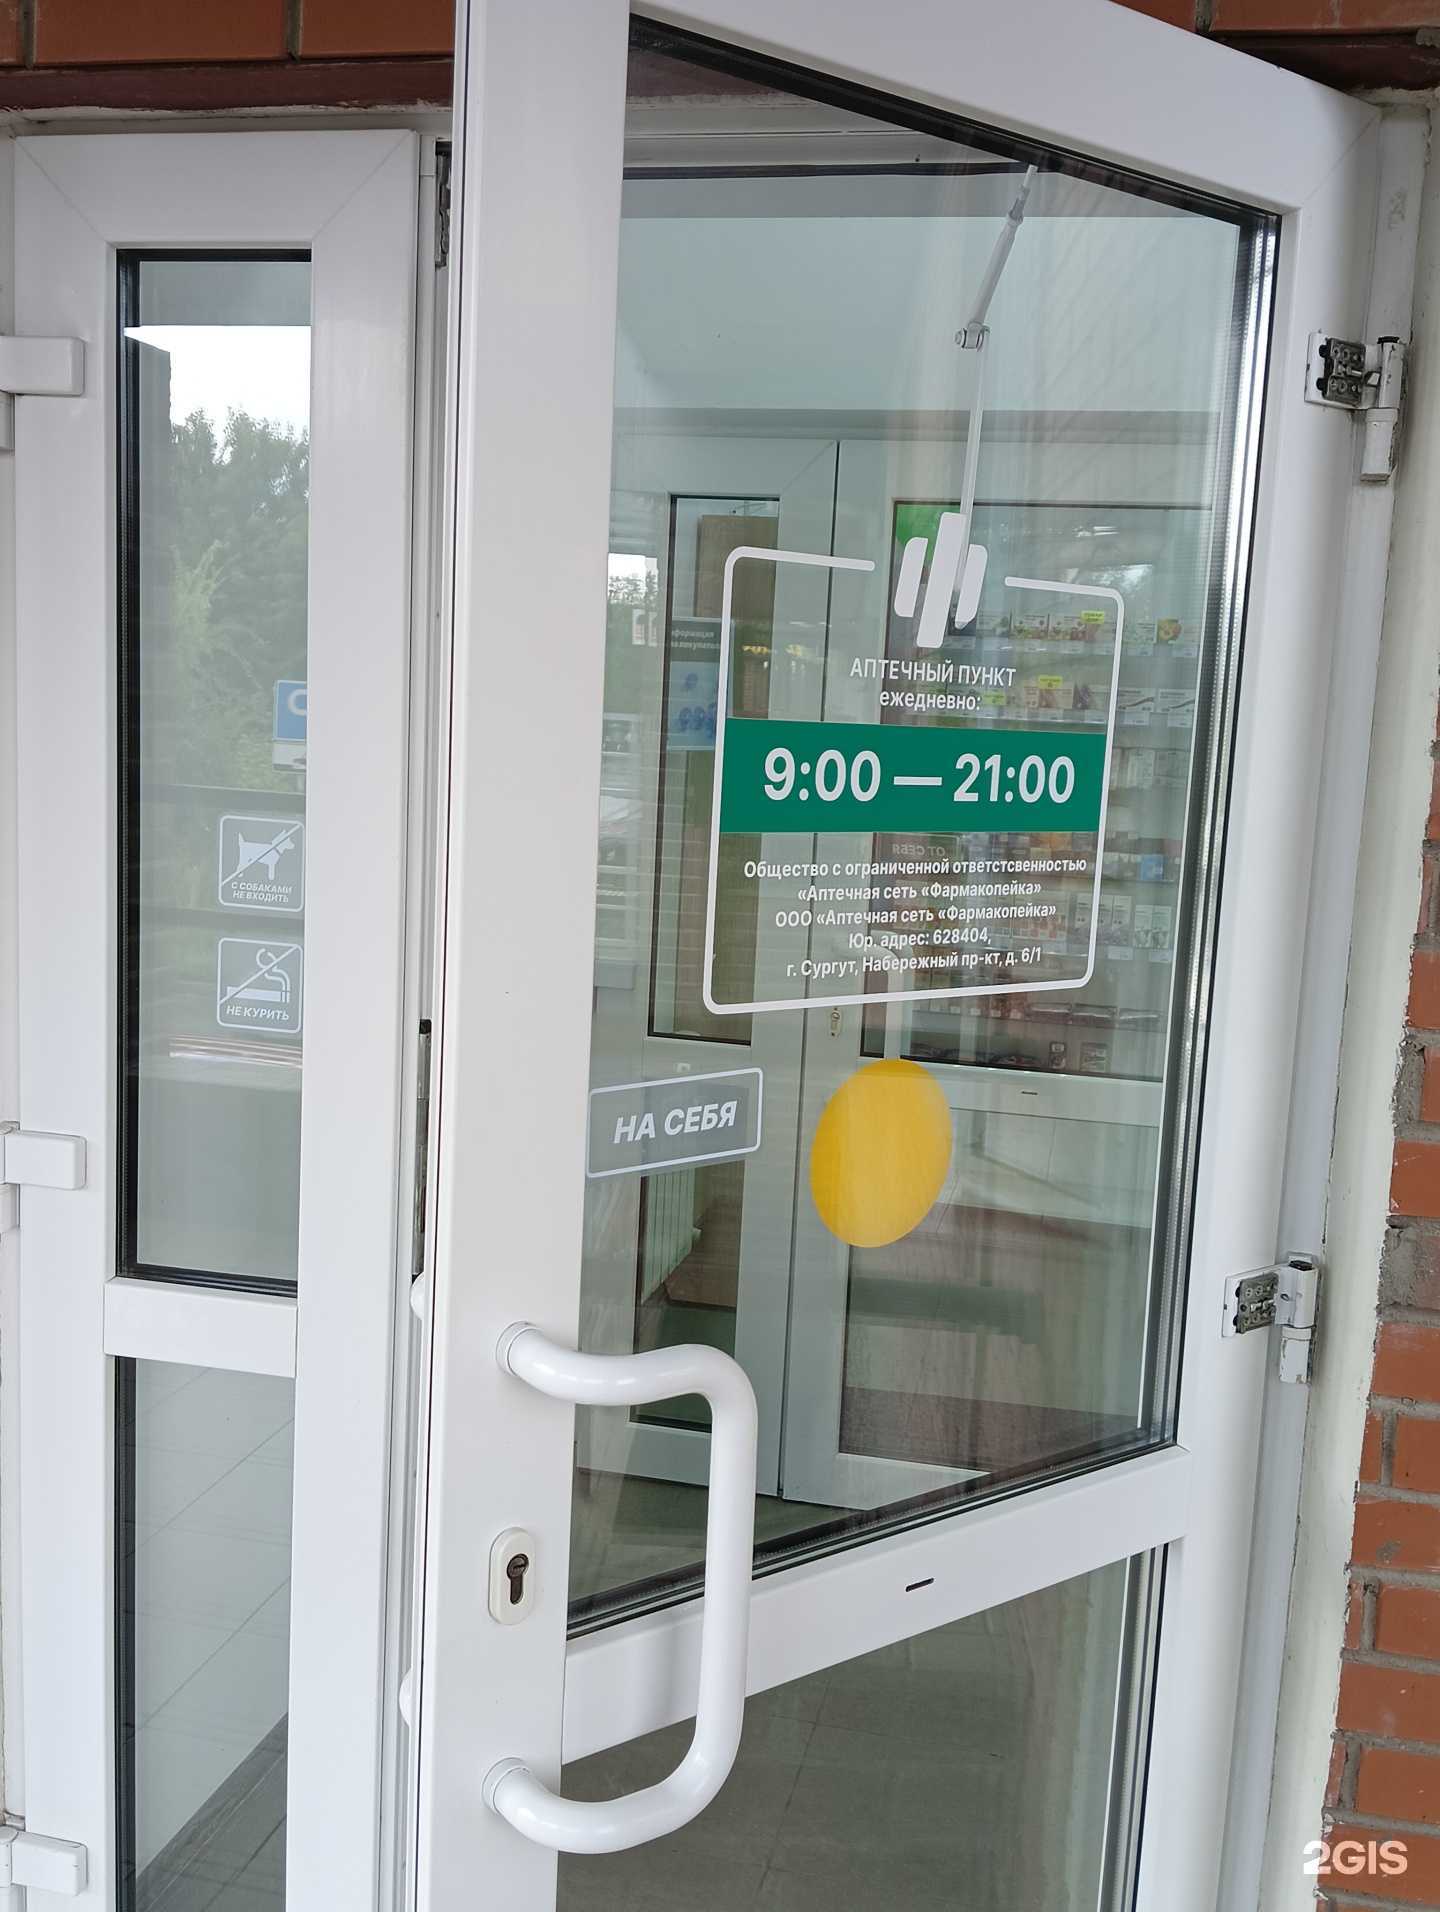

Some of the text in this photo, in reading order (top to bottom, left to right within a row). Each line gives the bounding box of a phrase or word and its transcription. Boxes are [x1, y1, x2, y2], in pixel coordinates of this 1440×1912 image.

[850, 658, 953, 684] АПТЕЧНЫЙ
[958, 665, 1017, 688] ПУНКТ
[879, 692, 981, 711] ежедневно:
[764, 747, 882, 802] 9:00
[953, 752, 1075, 804] 21:00
[744, 857, 1087, 880] Общество с ограниченной ответстсвенностью
[239, 882, 293, 895] СОБАКАМИ
[798, 880, 1042, 901] «Аптечная сеть «Фармакопейка»
[775, 902, 1057, 928] ООО «Аптечная сеть «Фармакопейка»
[849, 927, 991, 951] Юр. адрес: 628404,
[786, 946, 1042, 979] г. Сургут, Набережный пр-кт, д. 6/1
[226, 1005, 290, 1021] НЕ КУРИТЬ
[613, 1100, 738, 1144] НА СЕБЯ
